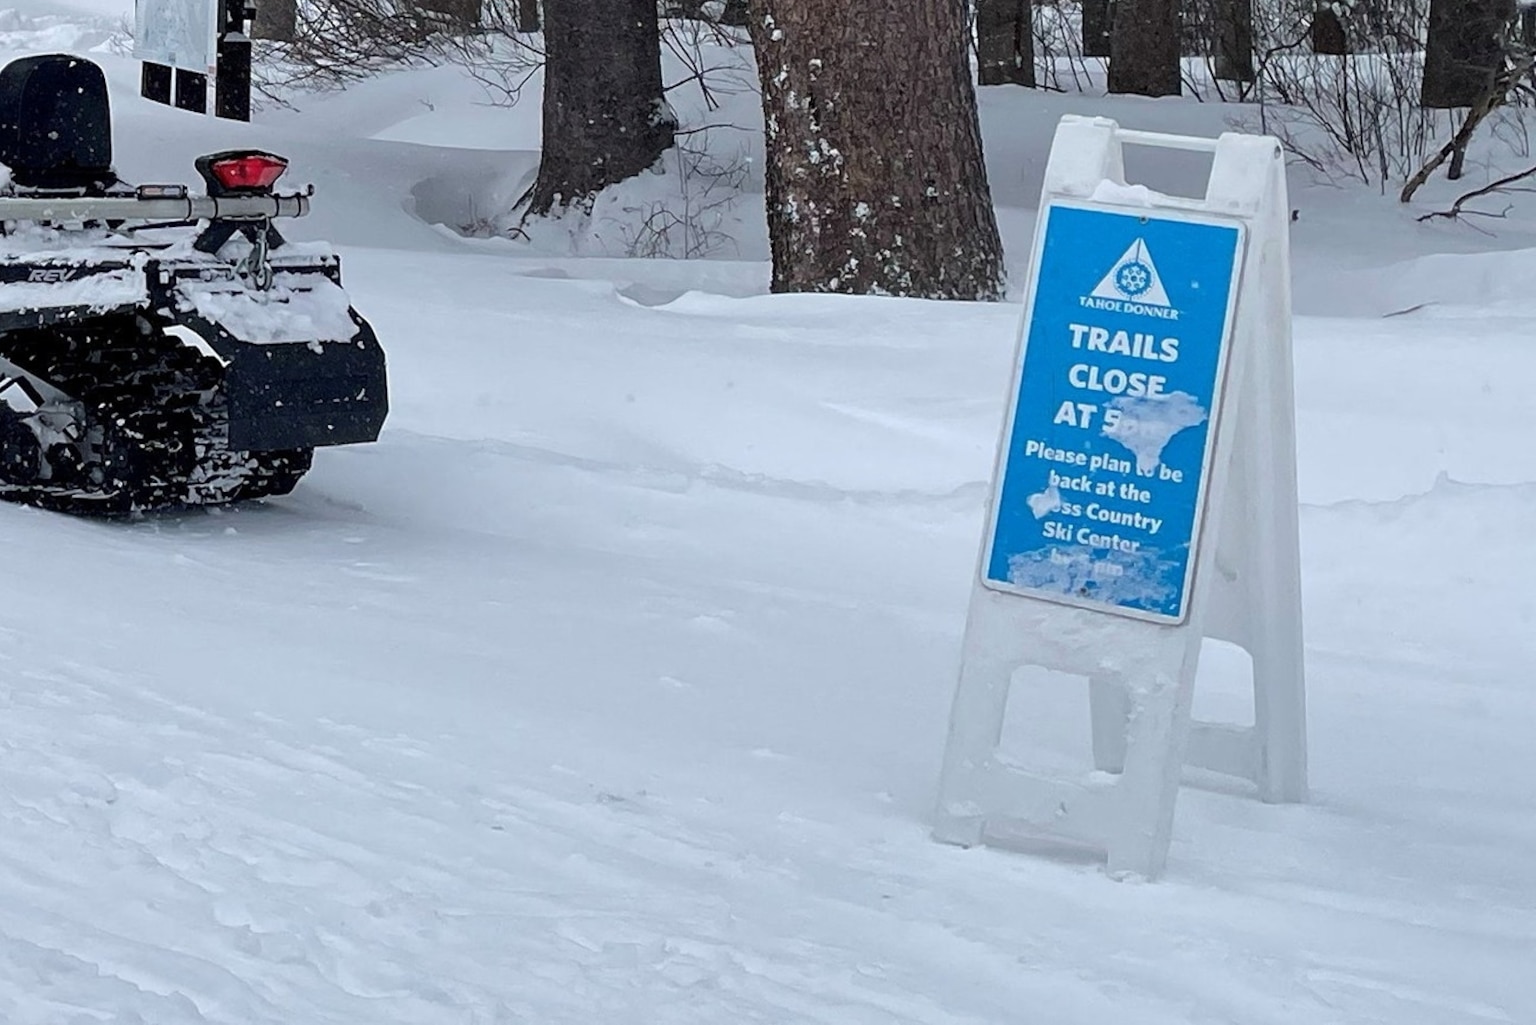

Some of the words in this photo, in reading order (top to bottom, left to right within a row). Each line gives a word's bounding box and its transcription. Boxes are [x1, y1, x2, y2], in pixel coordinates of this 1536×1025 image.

[27, 268, 77, 282] REV
[1079, 296, 1122, 312] TAHOE
[1124, 303, 1179, 320] DONNER
[1069, 323, 1179, 363] TRAILS
[1068, 363, 1167, 400] CLOSE
[1053, 400, 1098, 429] AT
[1025, 439, 1087, 466] Please
[1089, 453, 1131, 474] plan
[1159, 463, 1183, 483] be
[1049, 469, 1092, 492] back
[1095, 480, 1115, 497] at
[1119, 483, 1151, 503] the
[1086, 503, 1163, 535] Country
[1042, 521, 1073, 541] Ski
[1076, 527, 1140, 553] Center
